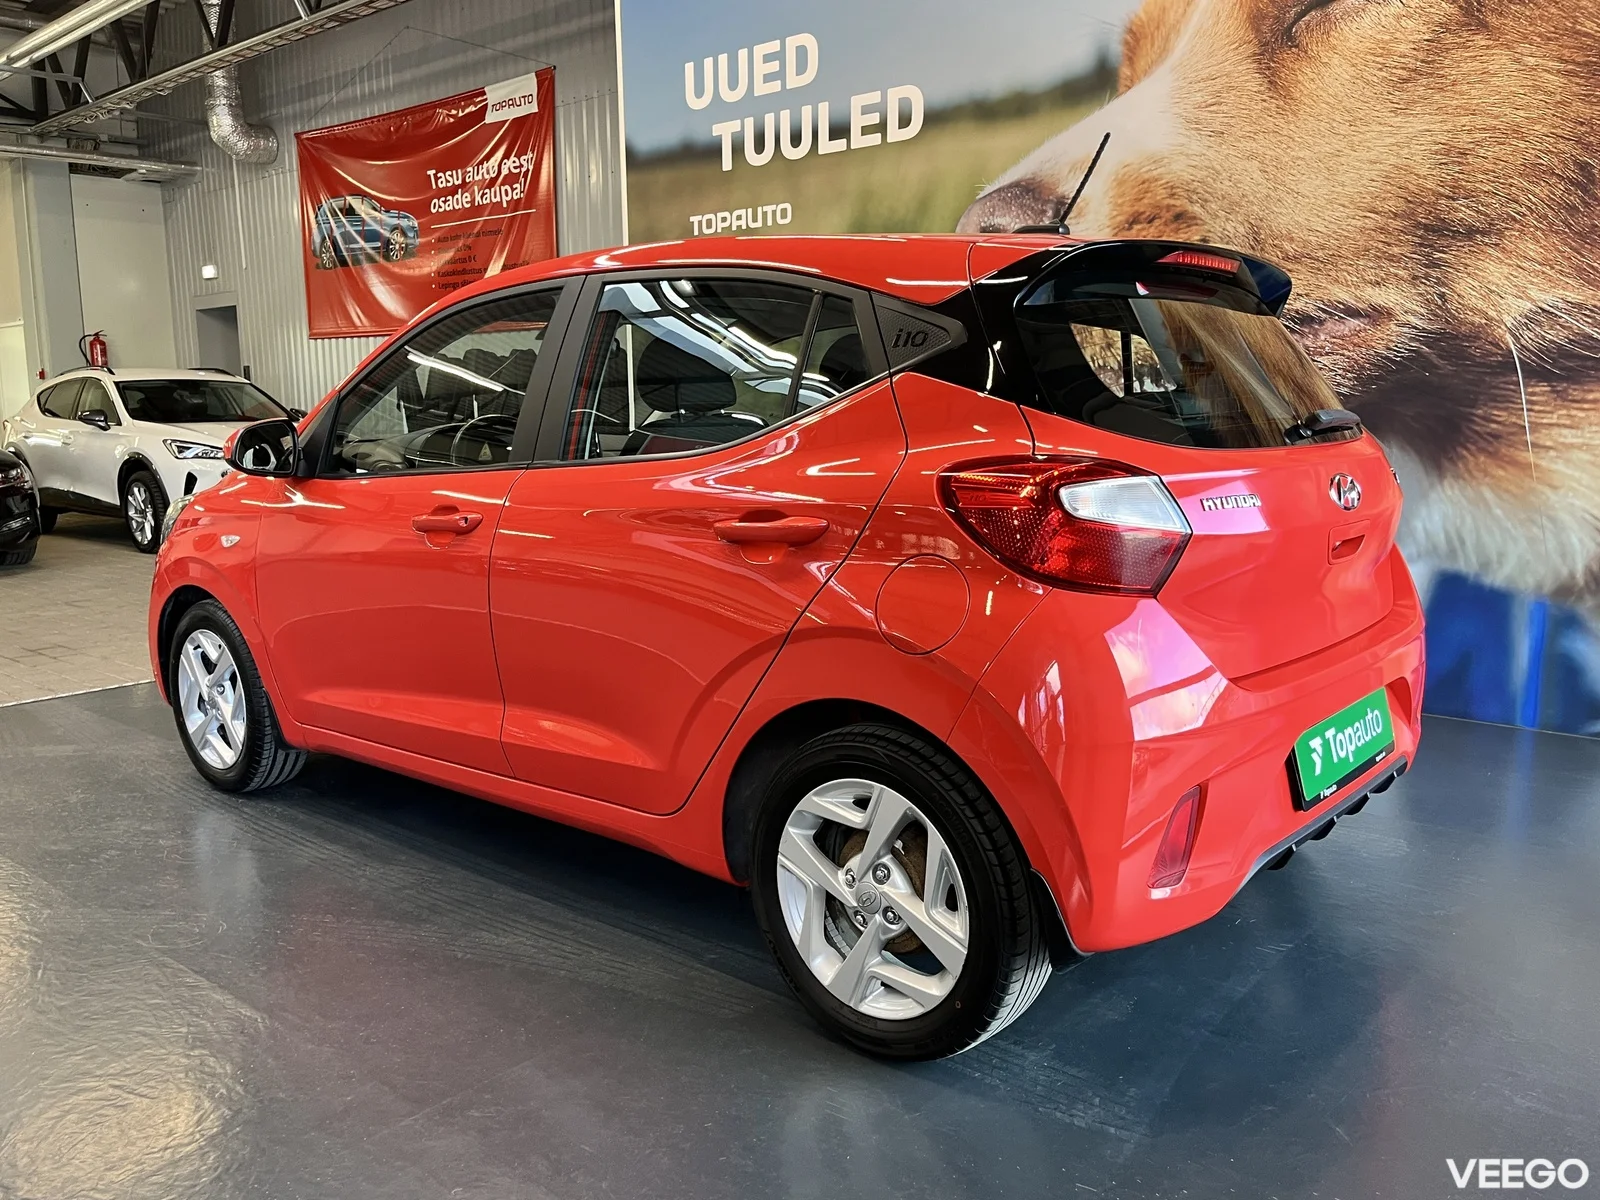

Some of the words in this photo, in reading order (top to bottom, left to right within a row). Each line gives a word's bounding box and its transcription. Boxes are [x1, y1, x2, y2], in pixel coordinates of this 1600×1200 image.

[684, 32, 819, 111] UUED
[491, 93, 534, 113] TOPAUTO
[711, 84, 925, 172] TUULED
[426, 168, 463, 190] Tasu
[465, 160, 499, 183] auto
[500, 151, 534, 175] eest
[430, 188, 472, 214] osade
[474, 177, 525, 208] kaupa!
[689, 202, 793, 236] TOPAUTO
[891, 328, 929, 349] i10
[1324, 707, 1383, 763] Topauto
